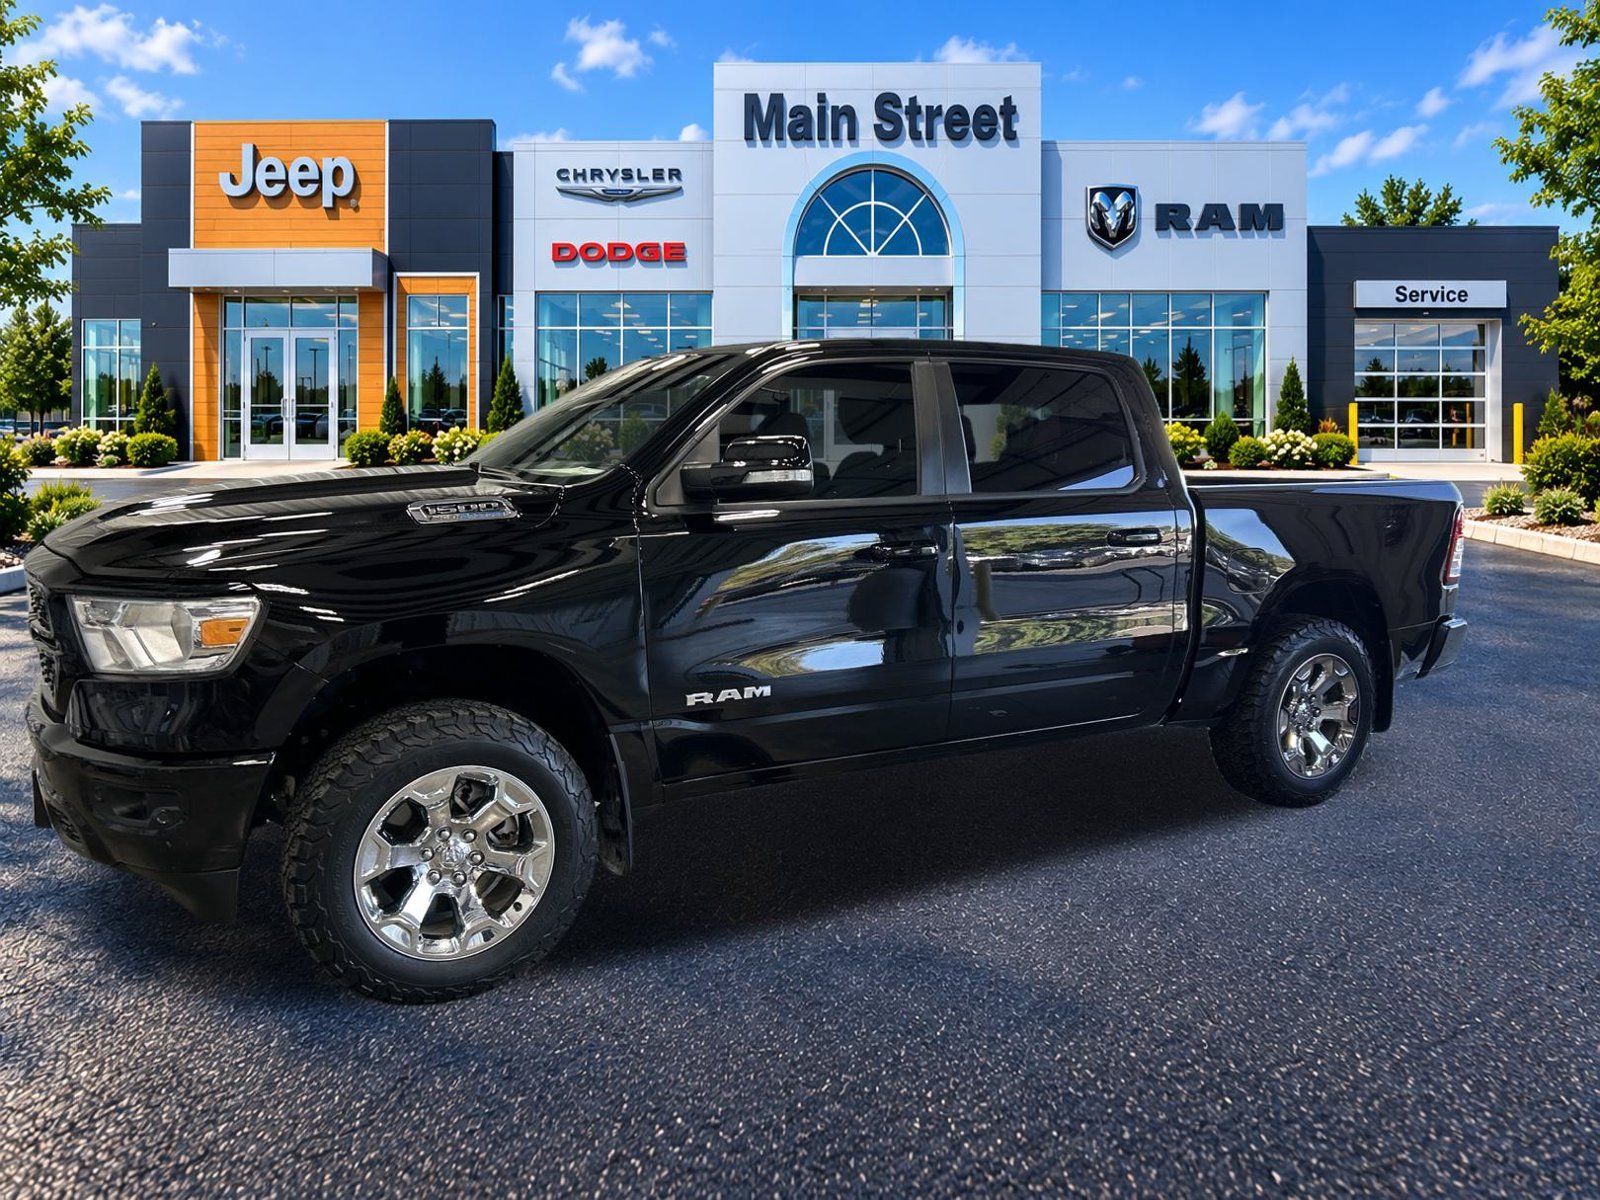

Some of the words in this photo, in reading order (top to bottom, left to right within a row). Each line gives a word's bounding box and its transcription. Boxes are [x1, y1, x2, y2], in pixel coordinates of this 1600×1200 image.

[743, 92, 857, 141] Main
[872, 91, 1018, 142] Street
[218, 143, 355, 208] Jeep
[555, 167, 683, 182] CHRYSLER
[1155, 203, 1284, 231] RAM
[551, 242, 687, 262] DODGE
[1395, 285, 1469, 303] Service
[425, 502, 500, 516] 1500
[685, 685, 772, 707] RAM
